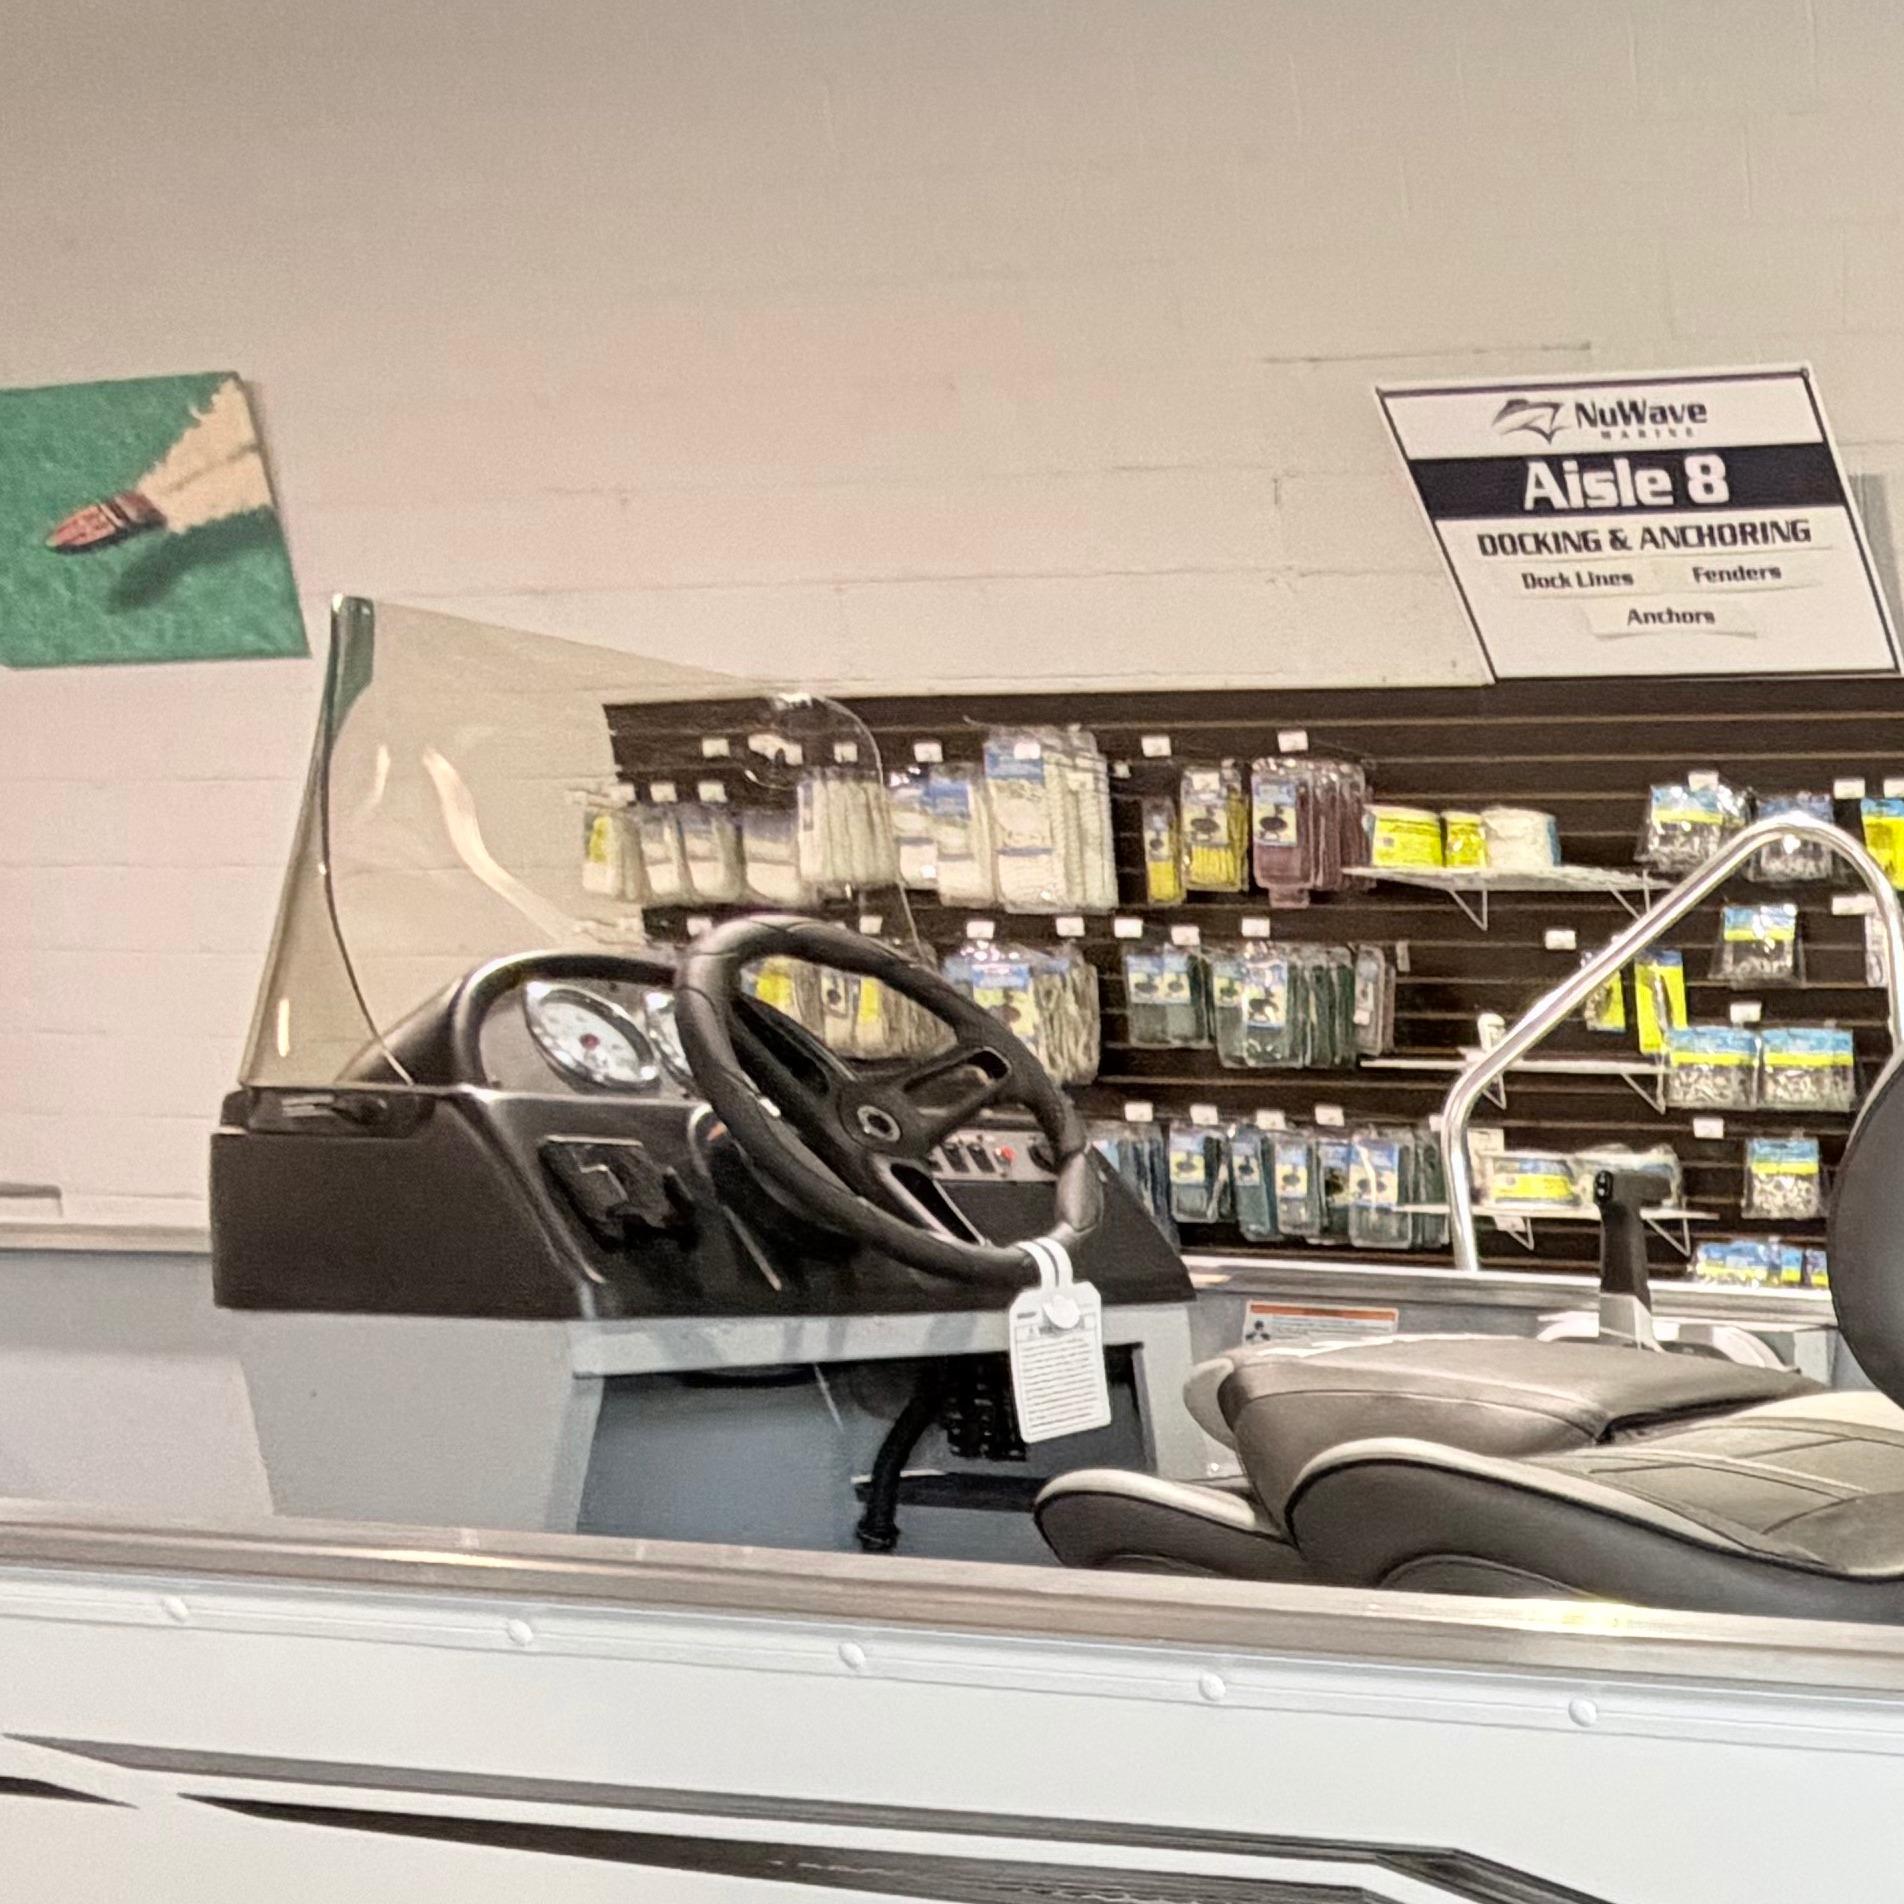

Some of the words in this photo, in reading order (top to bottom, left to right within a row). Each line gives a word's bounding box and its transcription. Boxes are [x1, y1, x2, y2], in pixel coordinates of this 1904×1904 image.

[1574, 399, 1709, 428] NuWave
[1523, 456, 1674, 512] Aisle
[1684, 453, 1729, 504] 8
[1477, 529, 1603, 557] DOCKING
[1608, 528, 1633, 552] &
[1639, 518, 1812, 551] ANCHORING
[1521, 570, 1572, 590] Dock
[1576, 570, 1635, 588] Lines
[1692, 564, 1783, 584] Fenders
[1626, 607, 1716, 627] Anchors
